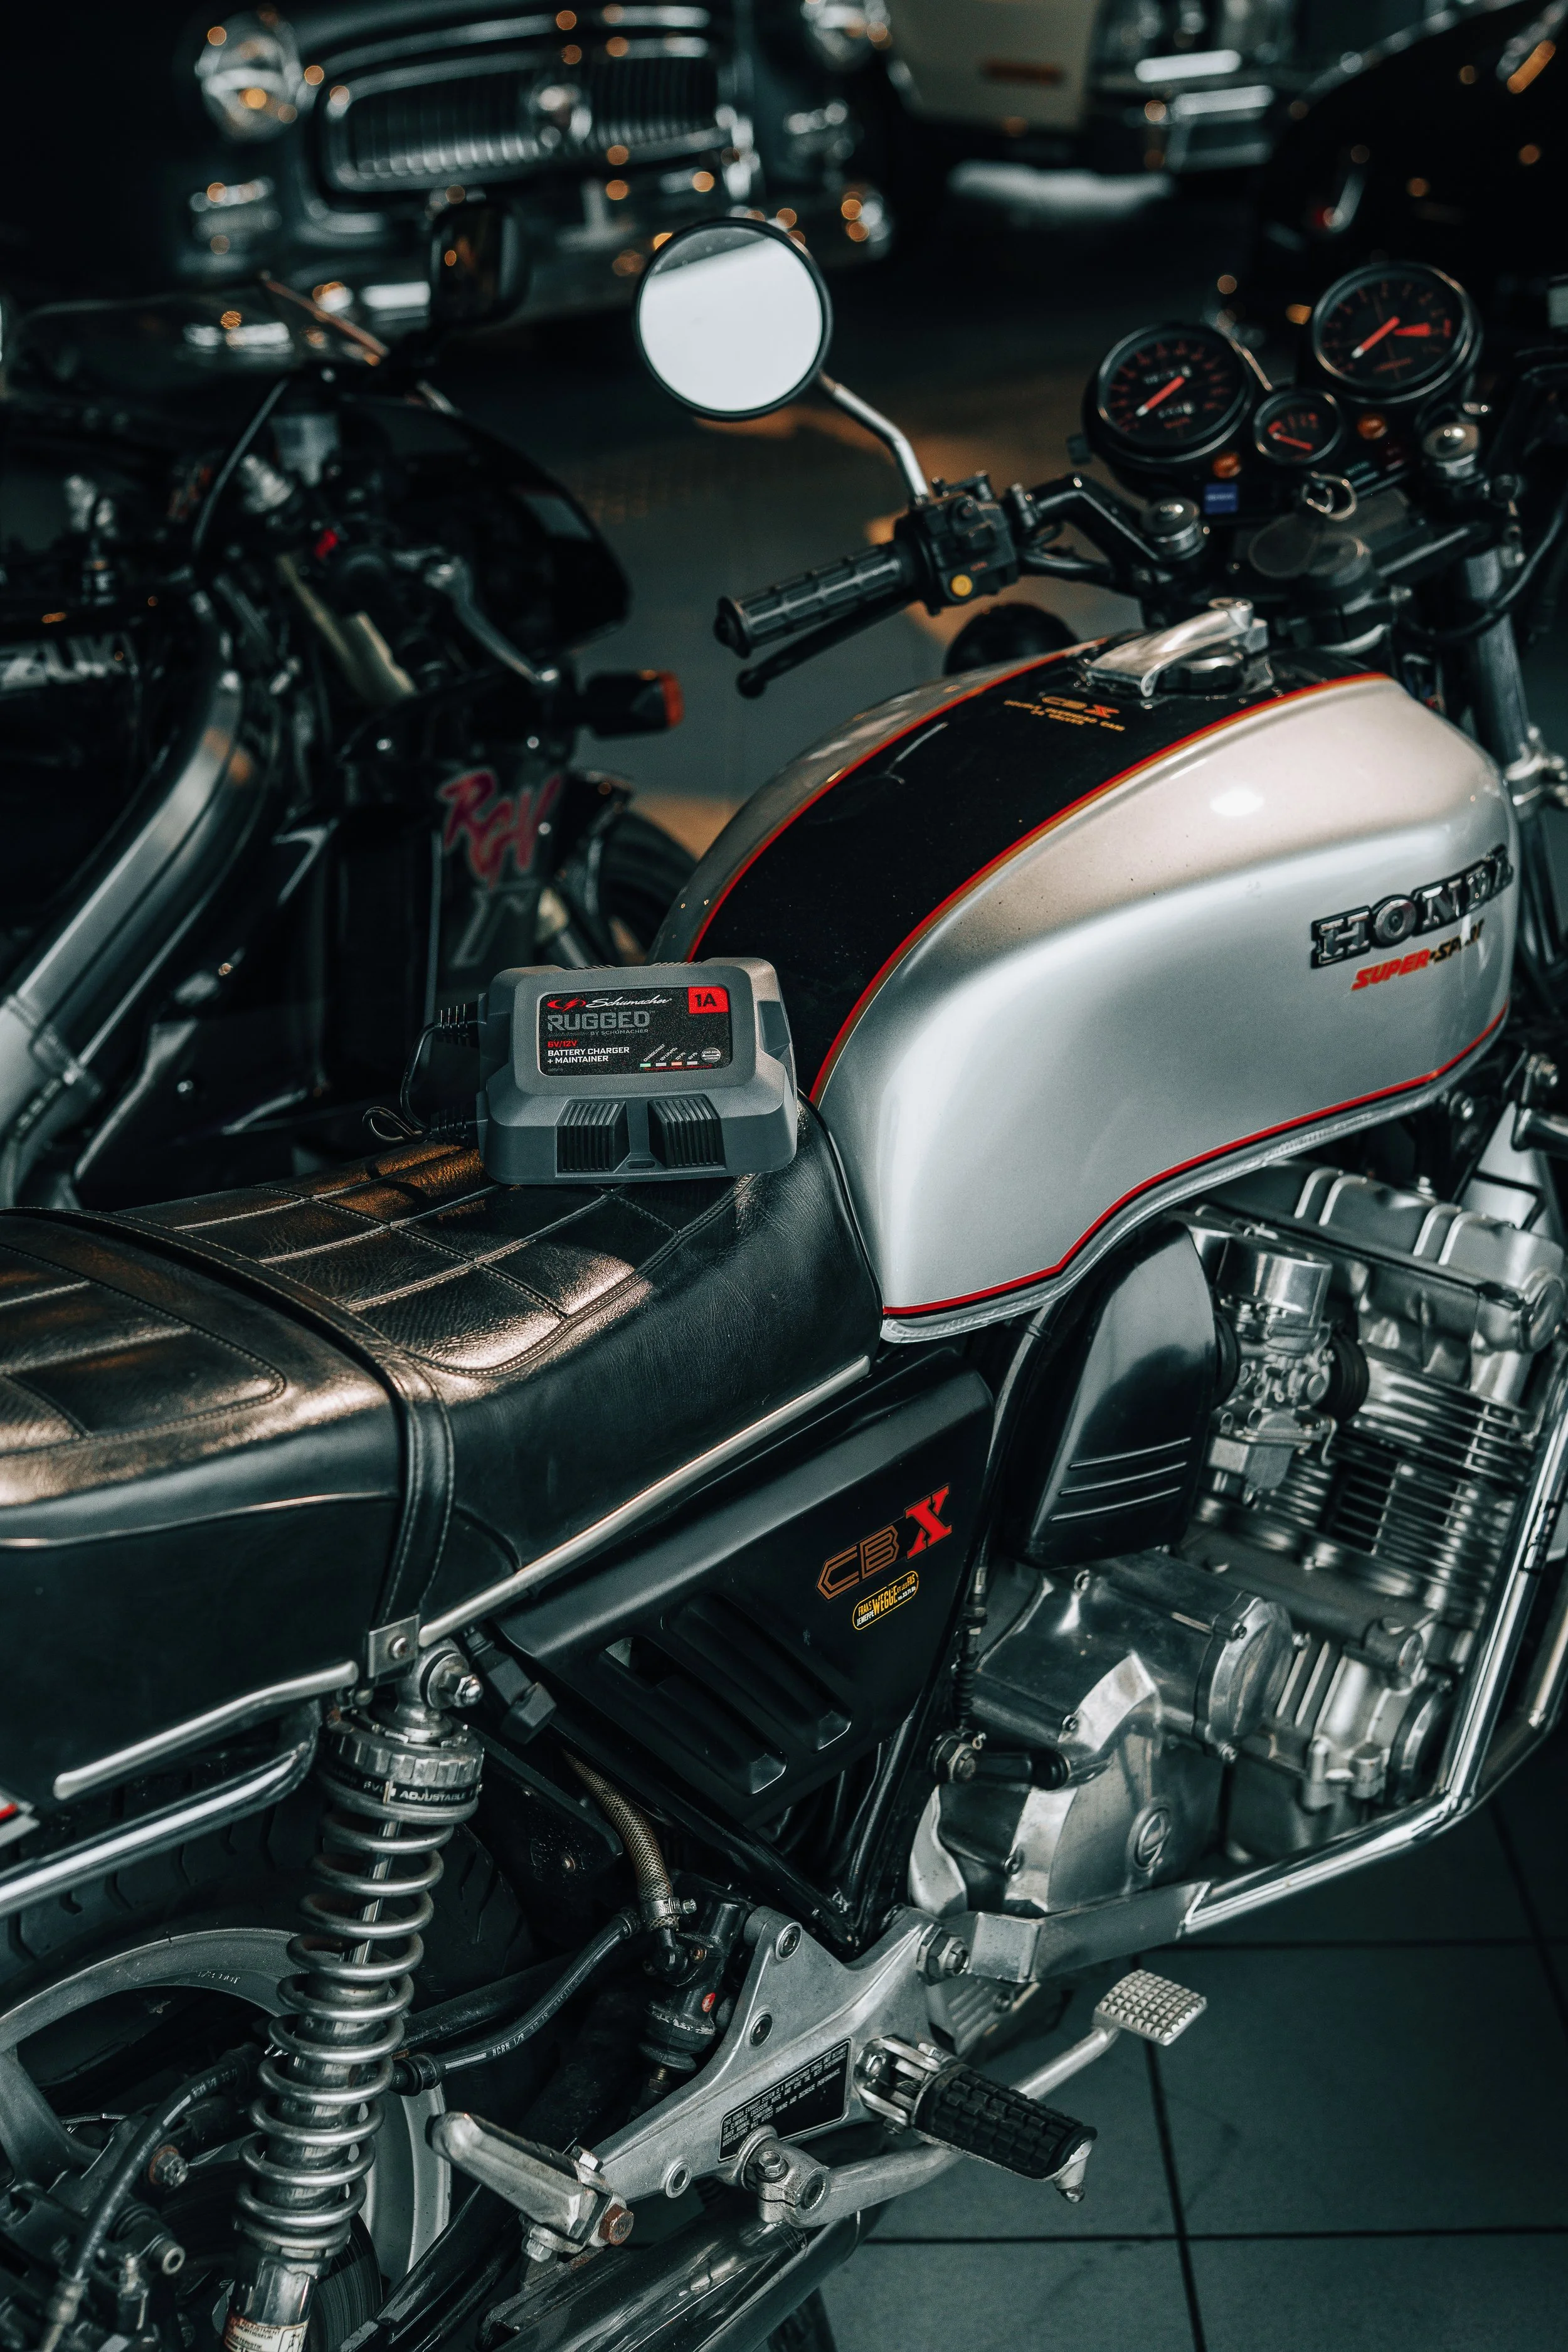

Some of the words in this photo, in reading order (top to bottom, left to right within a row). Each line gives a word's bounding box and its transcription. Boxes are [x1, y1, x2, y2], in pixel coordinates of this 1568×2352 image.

[1352, 948, 1431, 990] SUPER
[586, 994, 670, 1008] Schumacher
[694, 993, 717, 1007] 1A
[555, 1056, 608, 1064] MAINTAINER
[817, 1484, 952, 1601] CBX
[872, 1585, 898, 1616] WEGGE
[400, 1791, 466, 1802] ADJUSTABLE
